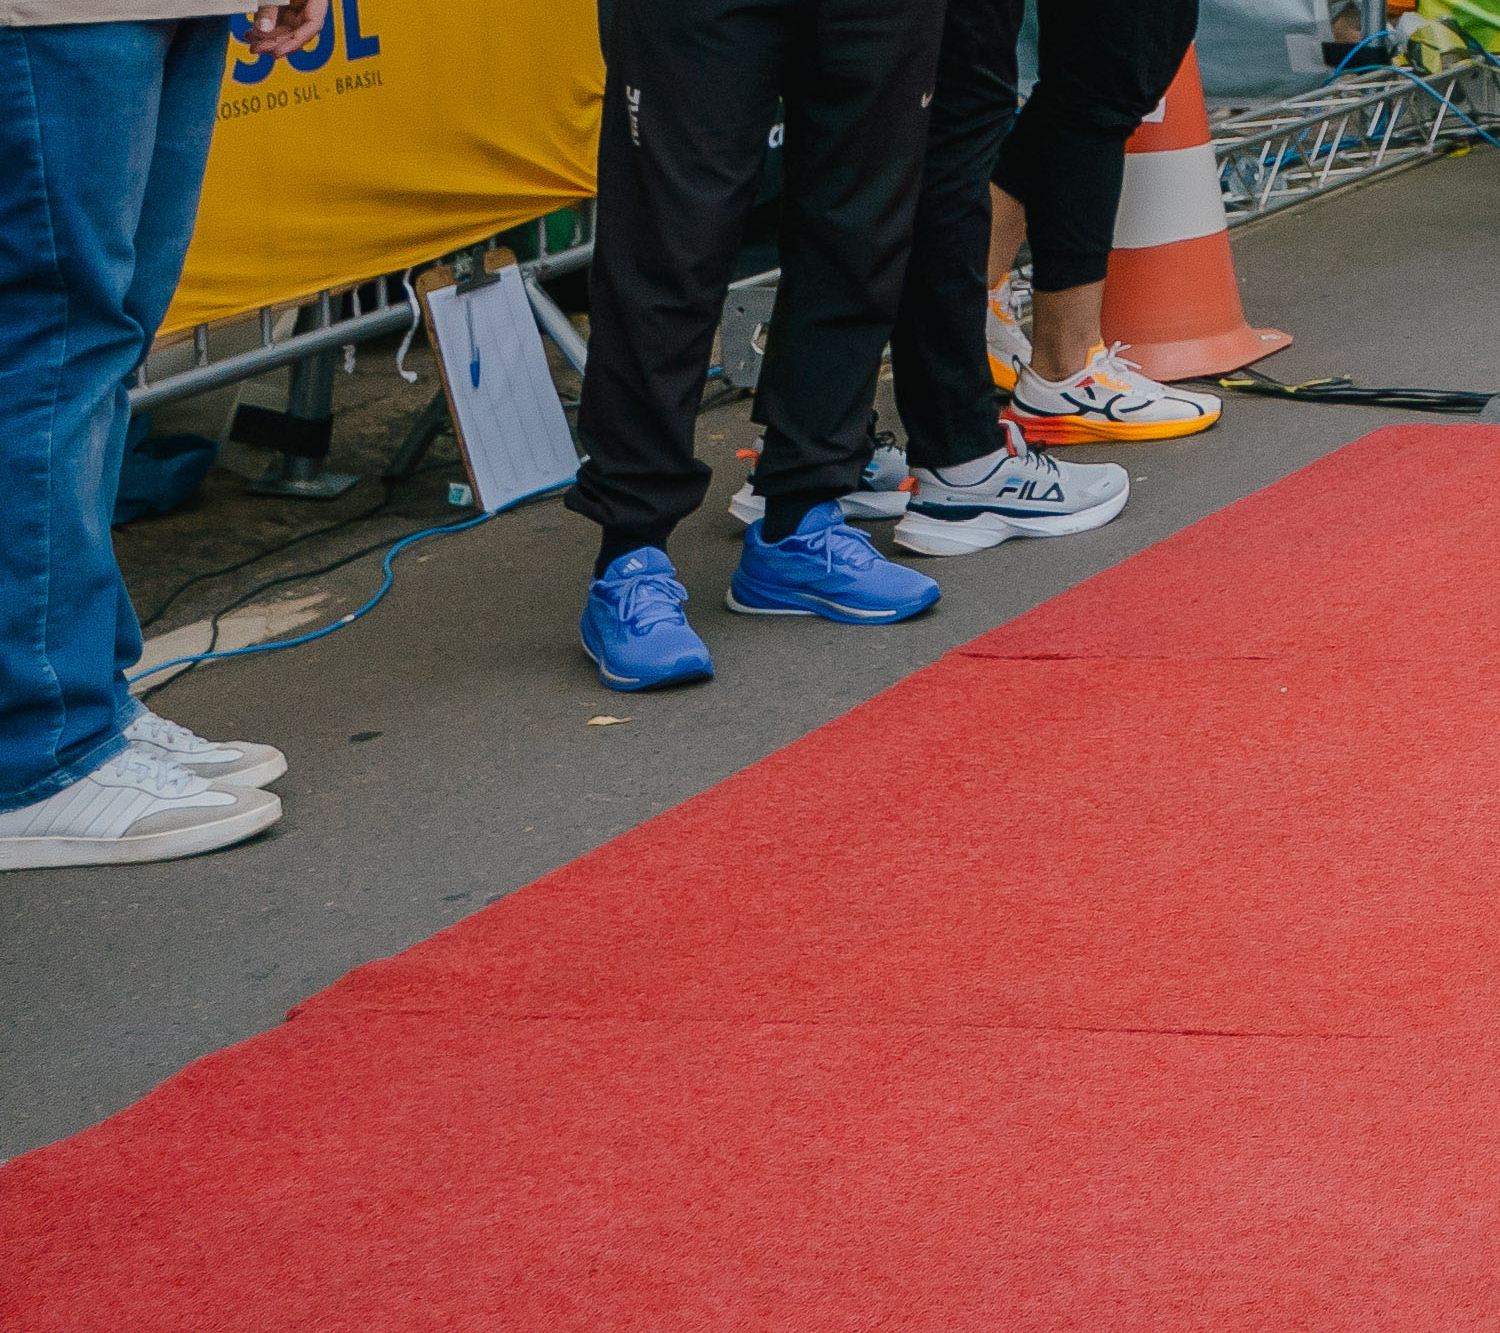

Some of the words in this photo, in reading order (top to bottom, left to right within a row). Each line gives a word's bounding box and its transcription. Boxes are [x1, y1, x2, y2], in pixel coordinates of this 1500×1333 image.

[215, 96, 261, 121] OSSO
[266, 90, 289, 113] DO
[293, 82, 320, 102] SUL
[335, 70, 383, 95] BRASIL
[996, 478, 1067, 503] FILA
